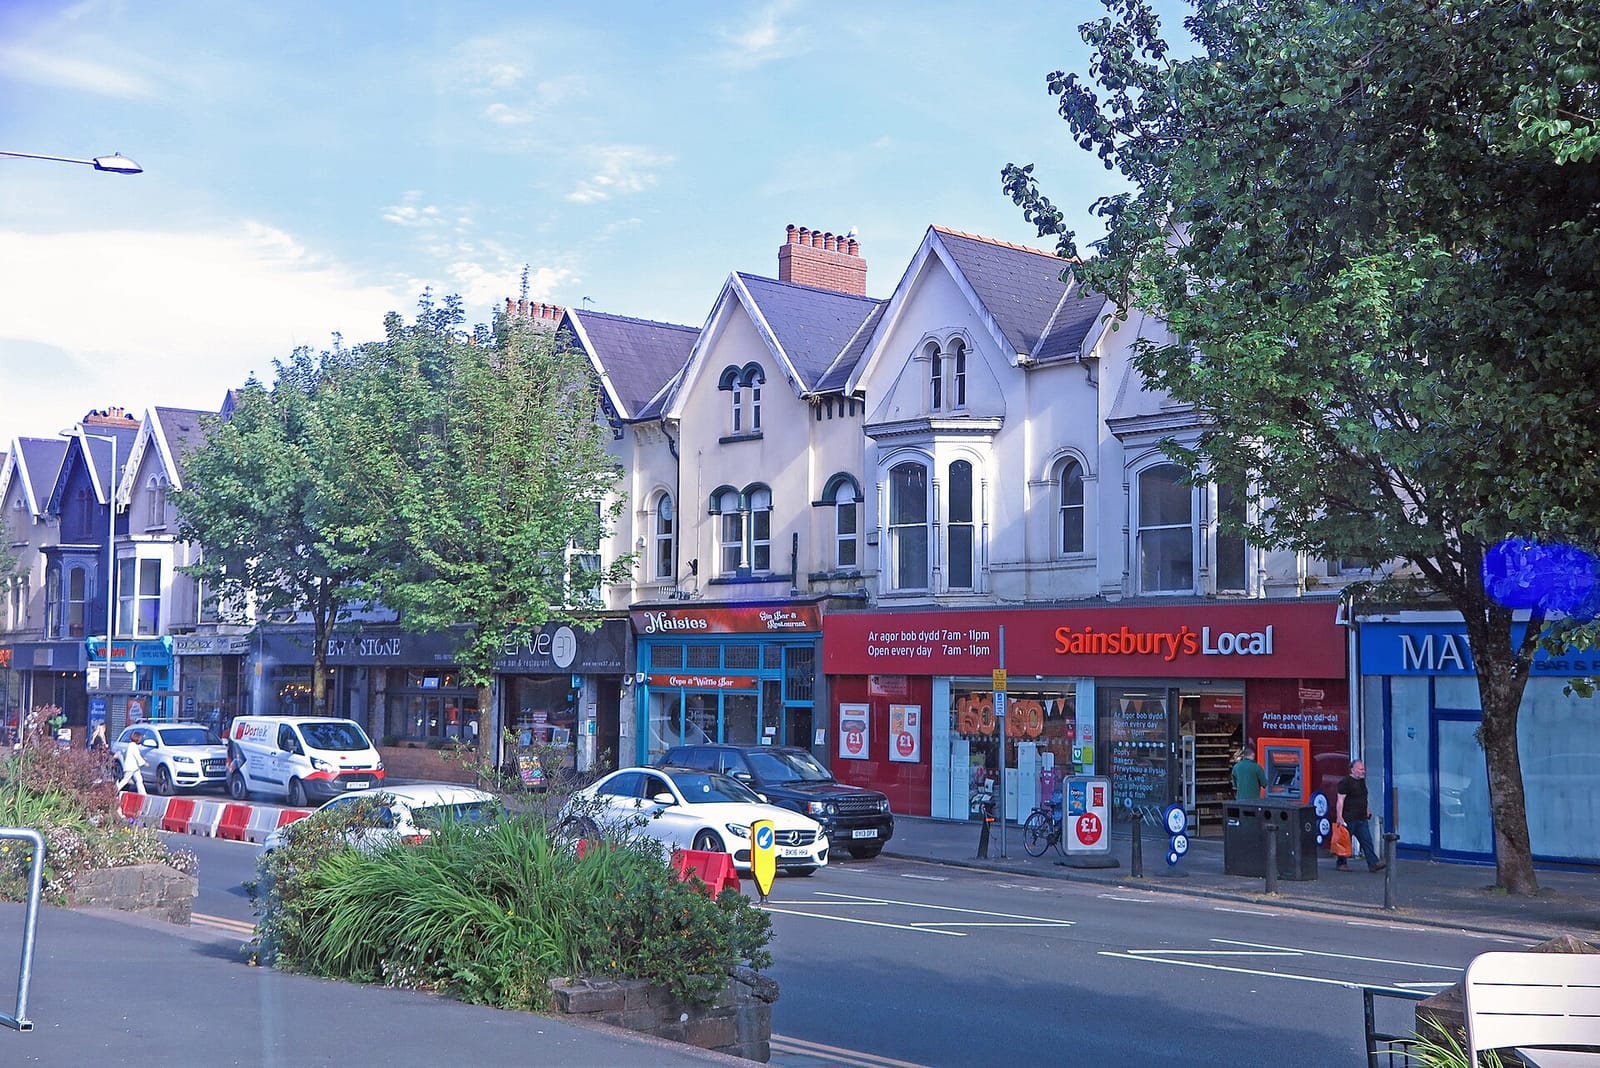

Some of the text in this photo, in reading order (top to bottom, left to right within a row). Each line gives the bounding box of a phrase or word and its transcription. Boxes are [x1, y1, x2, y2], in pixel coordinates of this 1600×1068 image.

[759, 611, 773, 621] Gin
[773, 610, 790, 621] Bar
[643, 611, 708, 633] Maisies
[767, 617, 807, 629] Restaurant
[868, 631, 878, 641] Ar
[880, 633, 899, 643] agor
[901, 630, 917, 641] bob
[918, 630, 940, 643] dydd
[941, 629, 961, 640] 7am
[969, 629, 990, 642] 11pm
[360, 638, 400, 656] STONE
[1055, 624, 1273, 661] Sainsbury's Local
[867, 645, 889, 657] Open
[891, 647, 914, 658] every
[916, 645, 932, 657] day
[941, 645, 961, 656] 7am
[969, 644, 990, 657] 11pm
[1535, 660, 1569, 671] BAR
[1573, 660, 1587, 671] &
[717, 676, 734, 688] Bar
[1113, 711, 1120, 719] Ar
[1148, 712, 1163, 720] dydd
[1262, 712, 1281, 720] Arian
[1282, 713, 1302, 721] parod
[1113, 720, 1128, 728] Open
[1146, 721, 1159, 729] day
[1262, 721, 1338, 731] Free cash withdrawals
[849, 732, 861, 744] £1
[900, 735, 911, 747] £1
[1113, 757, 1134, 765] Bakery
[1081, 817, 1098, 832] £1
